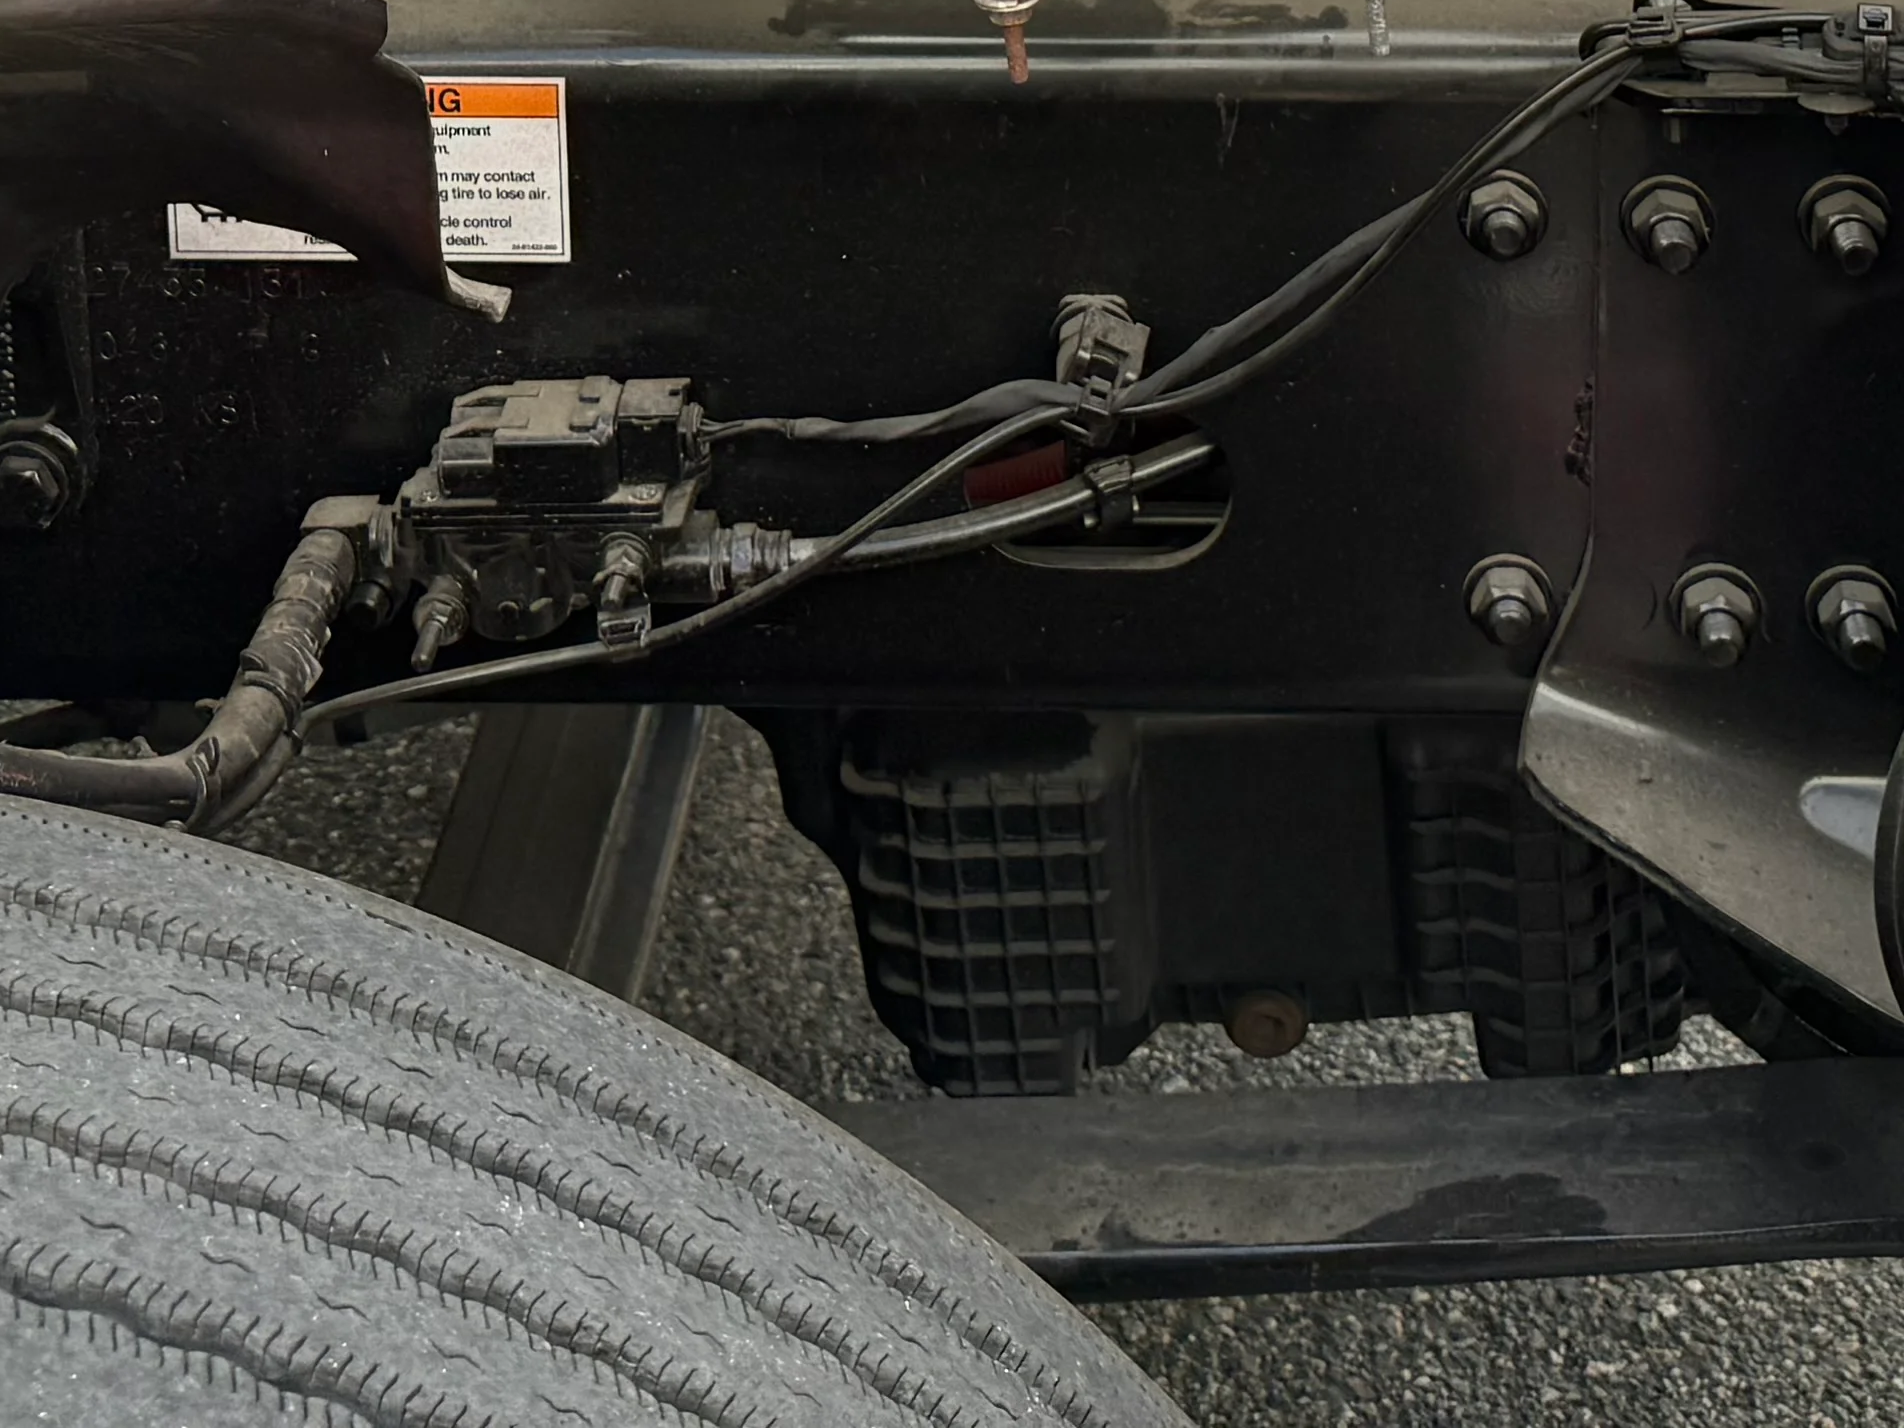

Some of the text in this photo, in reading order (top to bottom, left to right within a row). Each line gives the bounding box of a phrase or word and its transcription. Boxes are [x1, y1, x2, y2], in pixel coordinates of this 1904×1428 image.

[434, 124, 491, 139] uipment
[451, 171, 480, 185] may
[483, 170, 535, 183] contact
[452, 186, 475, 200] tire
[478, 187, 492, 200] to
[496, 186, 526, 200] lose
[528, 186, 551, 200] air.
[463, 215, 512, 229] control
[446, 233, 488, 247] death.
